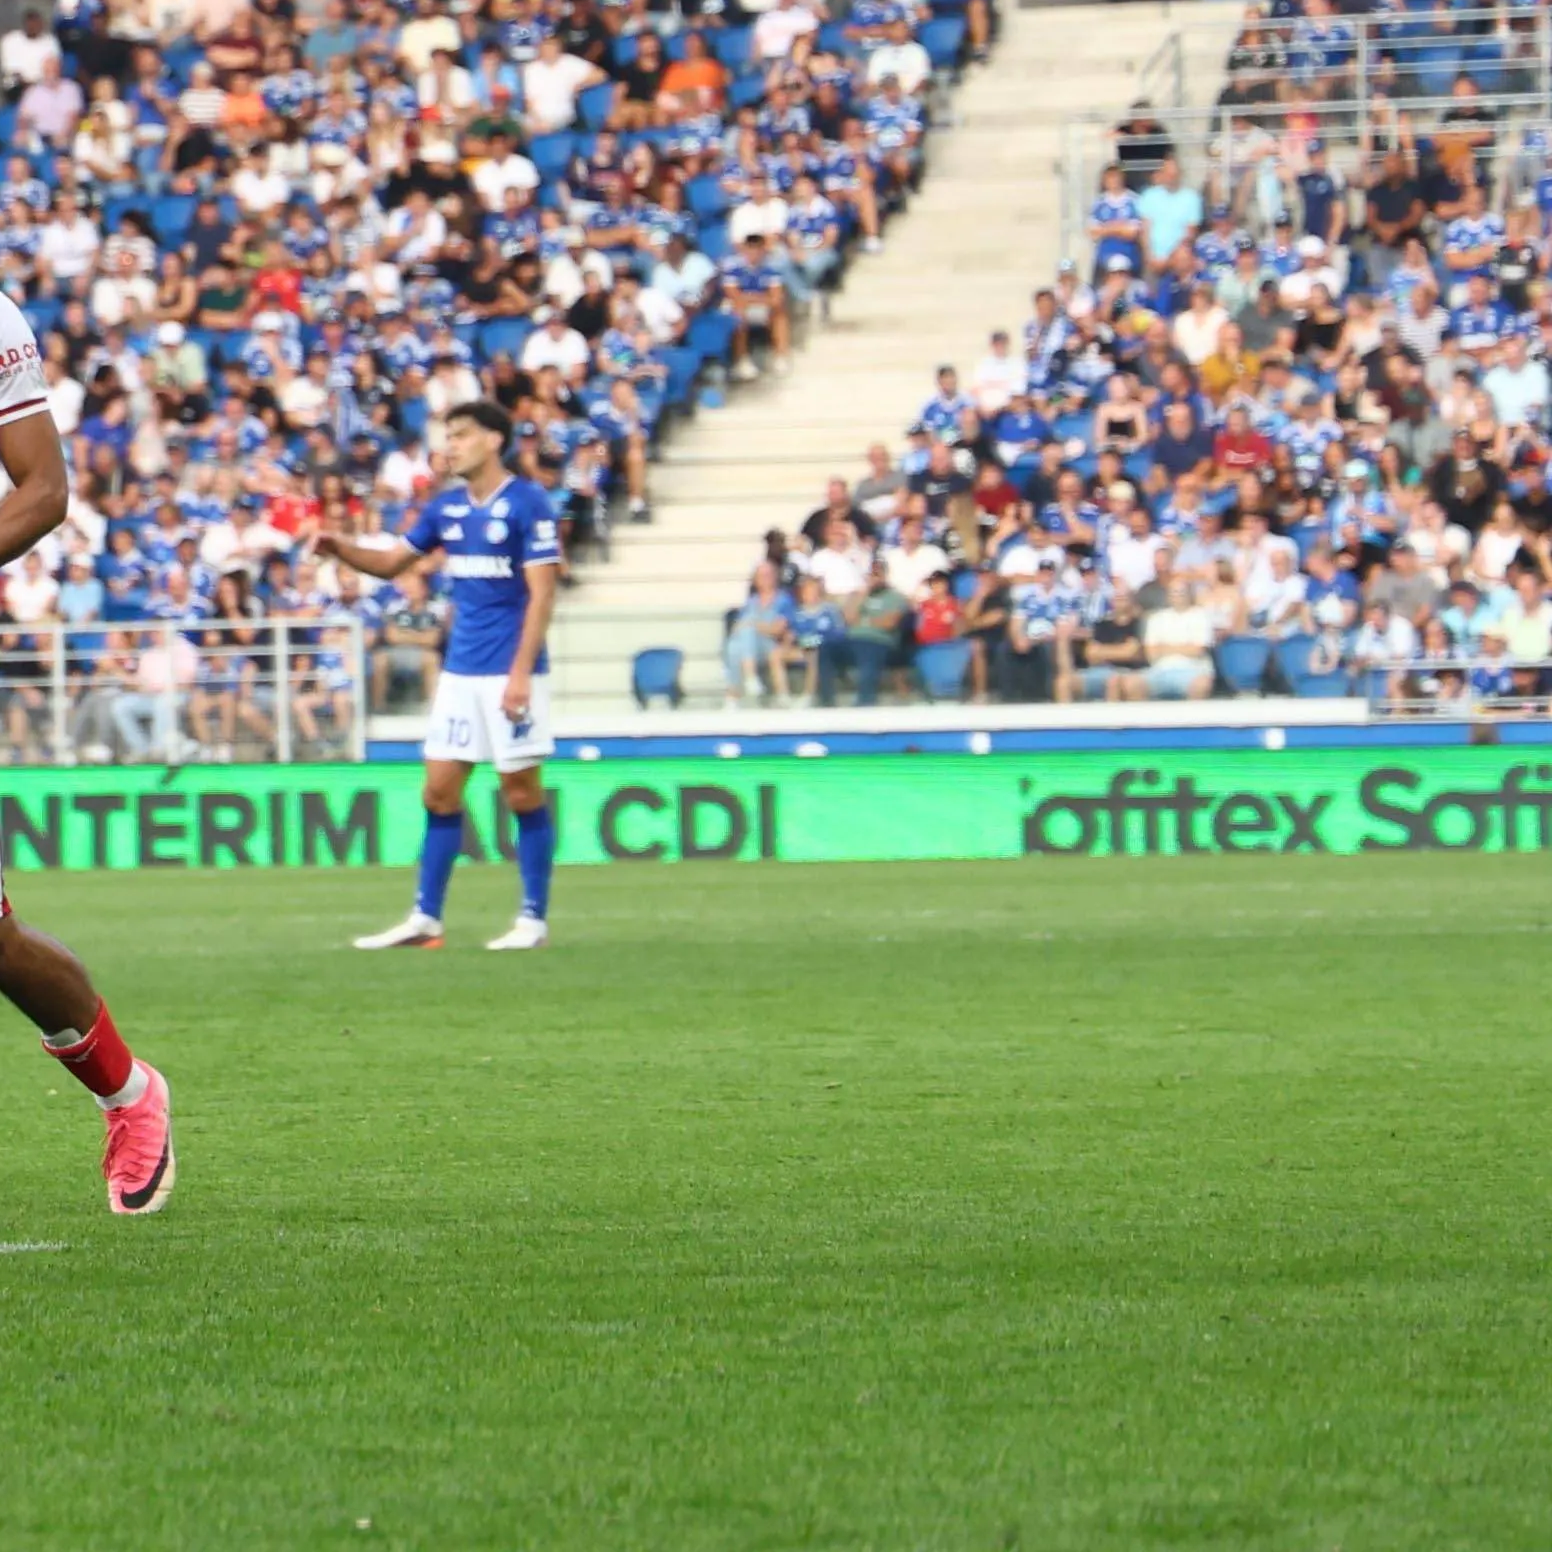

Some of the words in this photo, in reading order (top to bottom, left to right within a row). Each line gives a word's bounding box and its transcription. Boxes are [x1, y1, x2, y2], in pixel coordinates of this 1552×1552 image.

[446, 716, 471, 748] 10
[600, 784, 778, 860] CDI
[1019, 768, 1334, 854] ofitex
